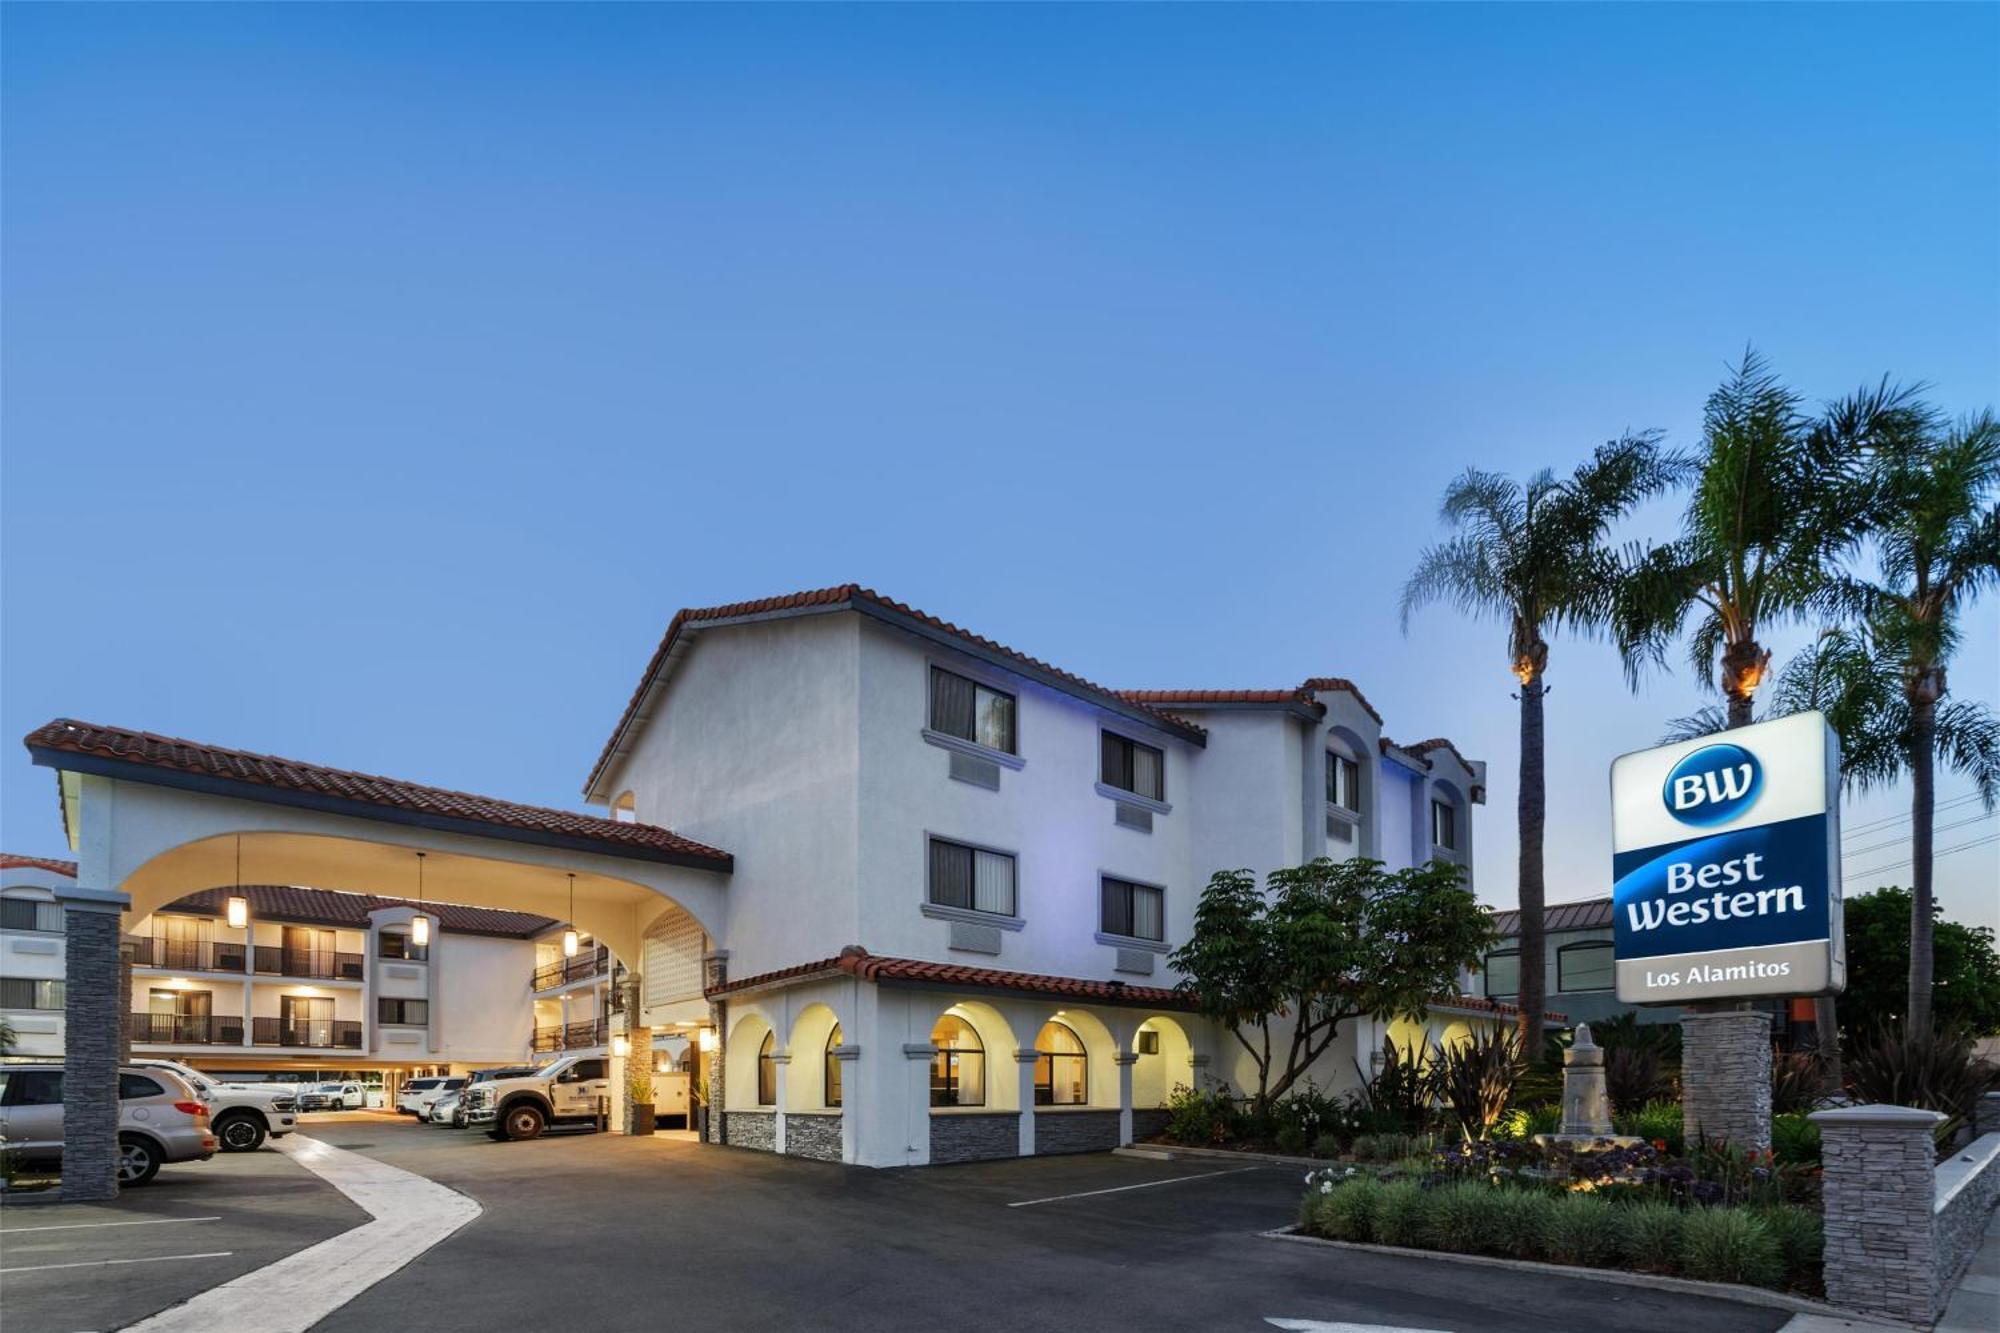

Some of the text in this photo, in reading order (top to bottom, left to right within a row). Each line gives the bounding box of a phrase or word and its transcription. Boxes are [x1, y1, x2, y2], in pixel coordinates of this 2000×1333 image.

[1674, 764, 1753, 810] BW
[1667, 852, 1764, 894] Best
[1628, 885, 1805, 932] Western
[1646, 961, 1790, 988] Los Alamitos
